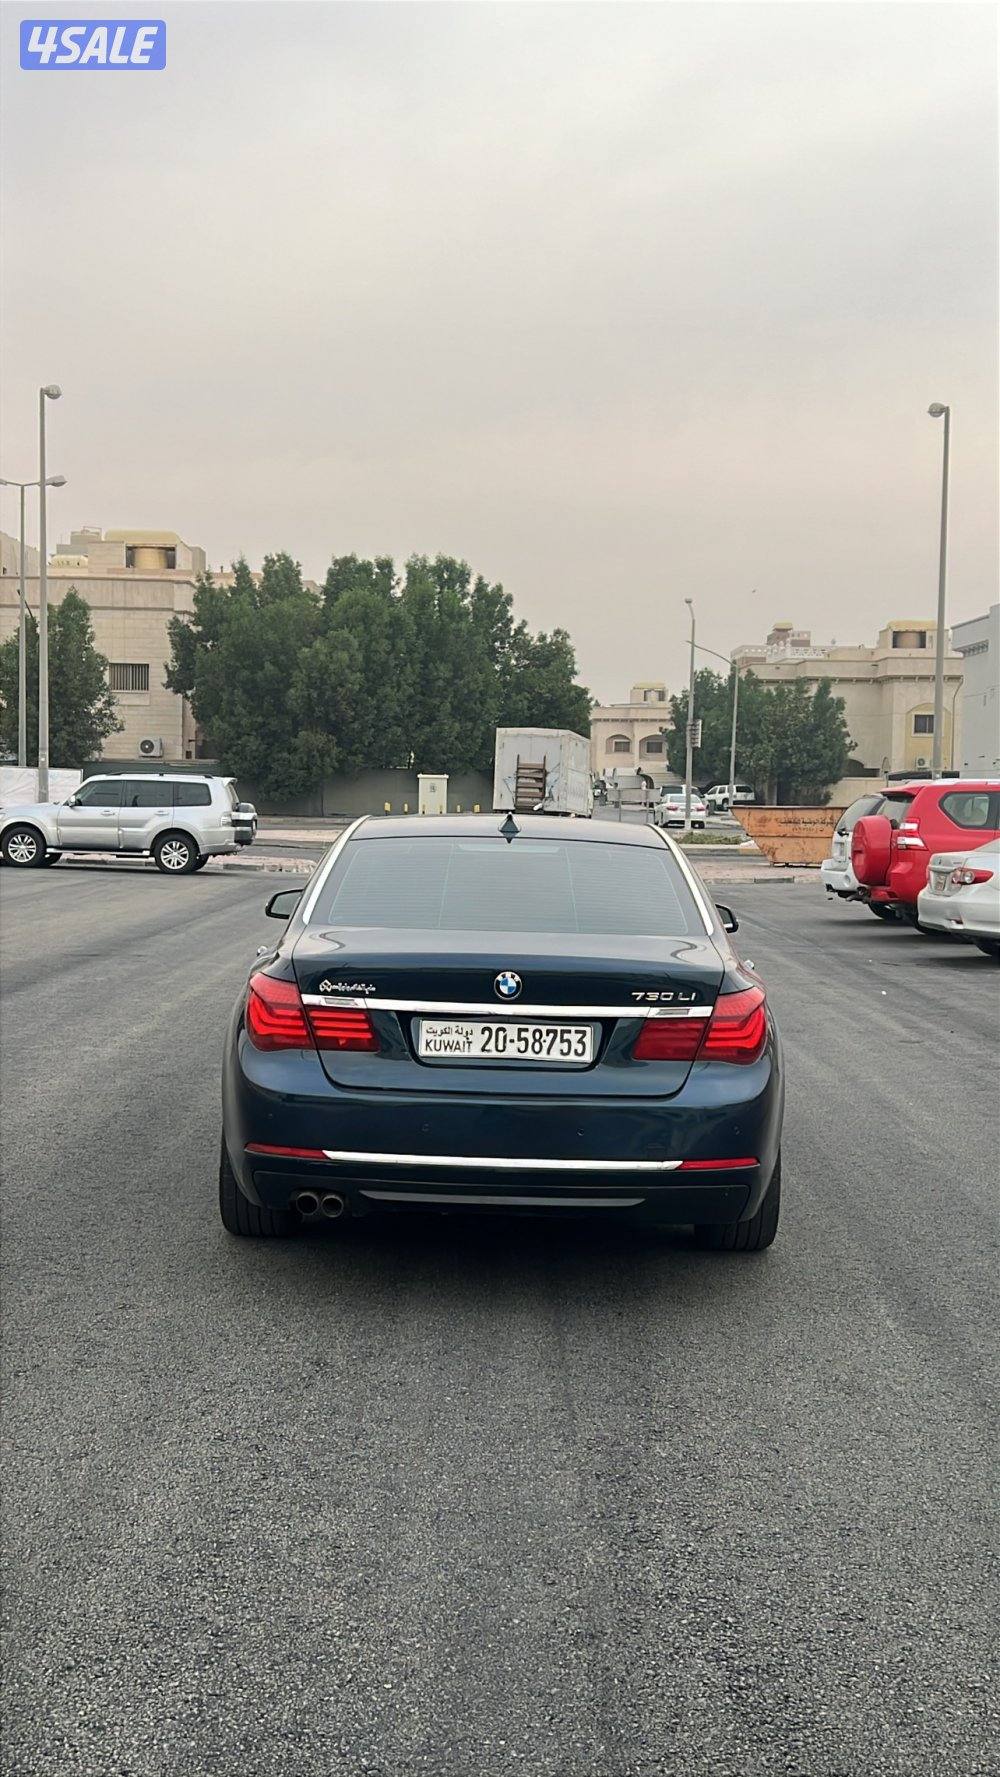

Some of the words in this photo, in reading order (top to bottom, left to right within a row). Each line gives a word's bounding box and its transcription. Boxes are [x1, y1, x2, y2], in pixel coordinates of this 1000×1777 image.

[425, 1027, 453, 1037] الكويت
[454, 1025, 473, 1037] دولة
[425, 1039, 473, 1053] KUWAIT
[480, 1026, 587, 1057] 20-58753
